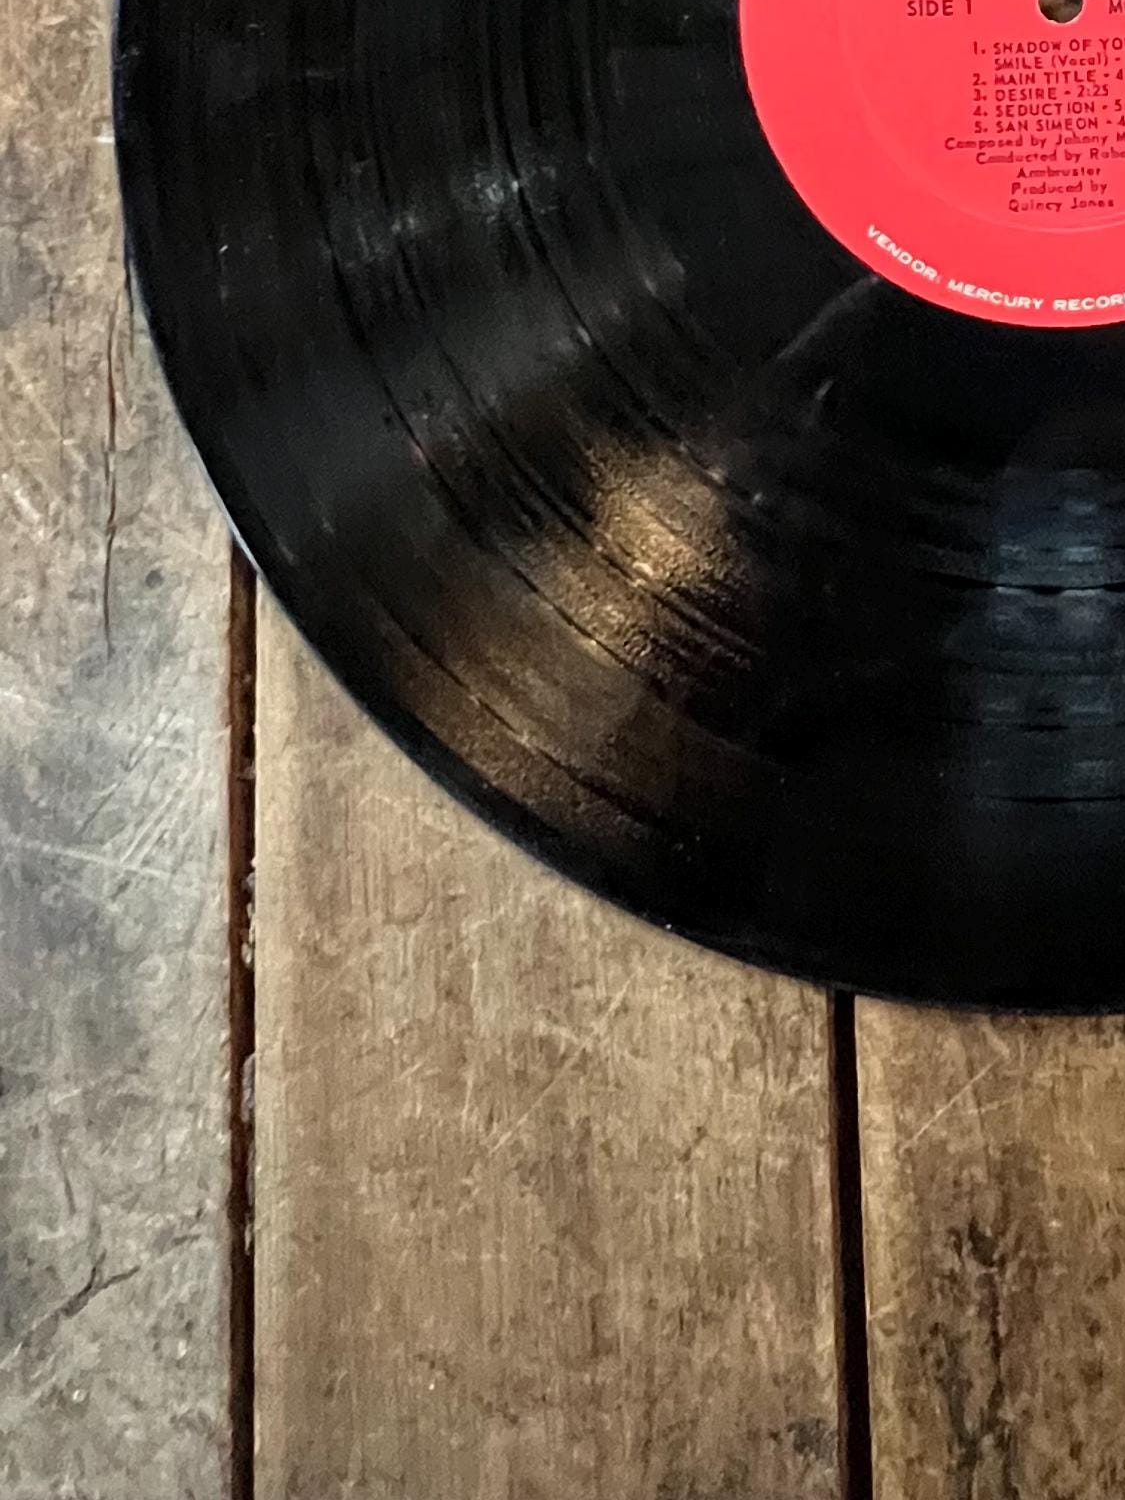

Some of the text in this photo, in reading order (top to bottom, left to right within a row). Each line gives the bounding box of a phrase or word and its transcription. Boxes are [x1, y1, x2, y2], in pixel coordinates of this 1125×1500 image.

[907, 0, 953, 16] SIDE
[973, 41, 986, 54] 1.
[993, 41, 1062, 55] SHADOW
[1069, 39, 1092, 51] OF
[994, 57, 1043, 70] SMILE
[1052, 52, 1108, 70] (Vocal)
[972, 73, 986, 86] 2.
[995, 72, 1035, 85] MAIN
[1044, 70, 1096, 84] TITLE
[973, 89, 987, 101] 3.
[995, 87, 1057, 101] DESIRE
[1077, 84, 1108, 97] 2:25
[973, 105, 988, 117] 4.
[995, 102, 1094, 117] SEDUCTION
[974, 121, 988, 133] 5.
[996, 120, 1028, 133] SAN
[1036, 117, 1098, 131] SIMEON
[945, 135, 1023, 150] Composed
[1031, 132, 1047, 148] by
[1055, 131, 1108, 146] Johnny
[976, 150, 1056, 164] Conducted
[1064, 150, 1081, 163] by
[1011, 180, 1107, 195] Produced by
[1008, 198, 1114, 212] Quincy Jones
[947, 279, 1044, 310] MERCURY
